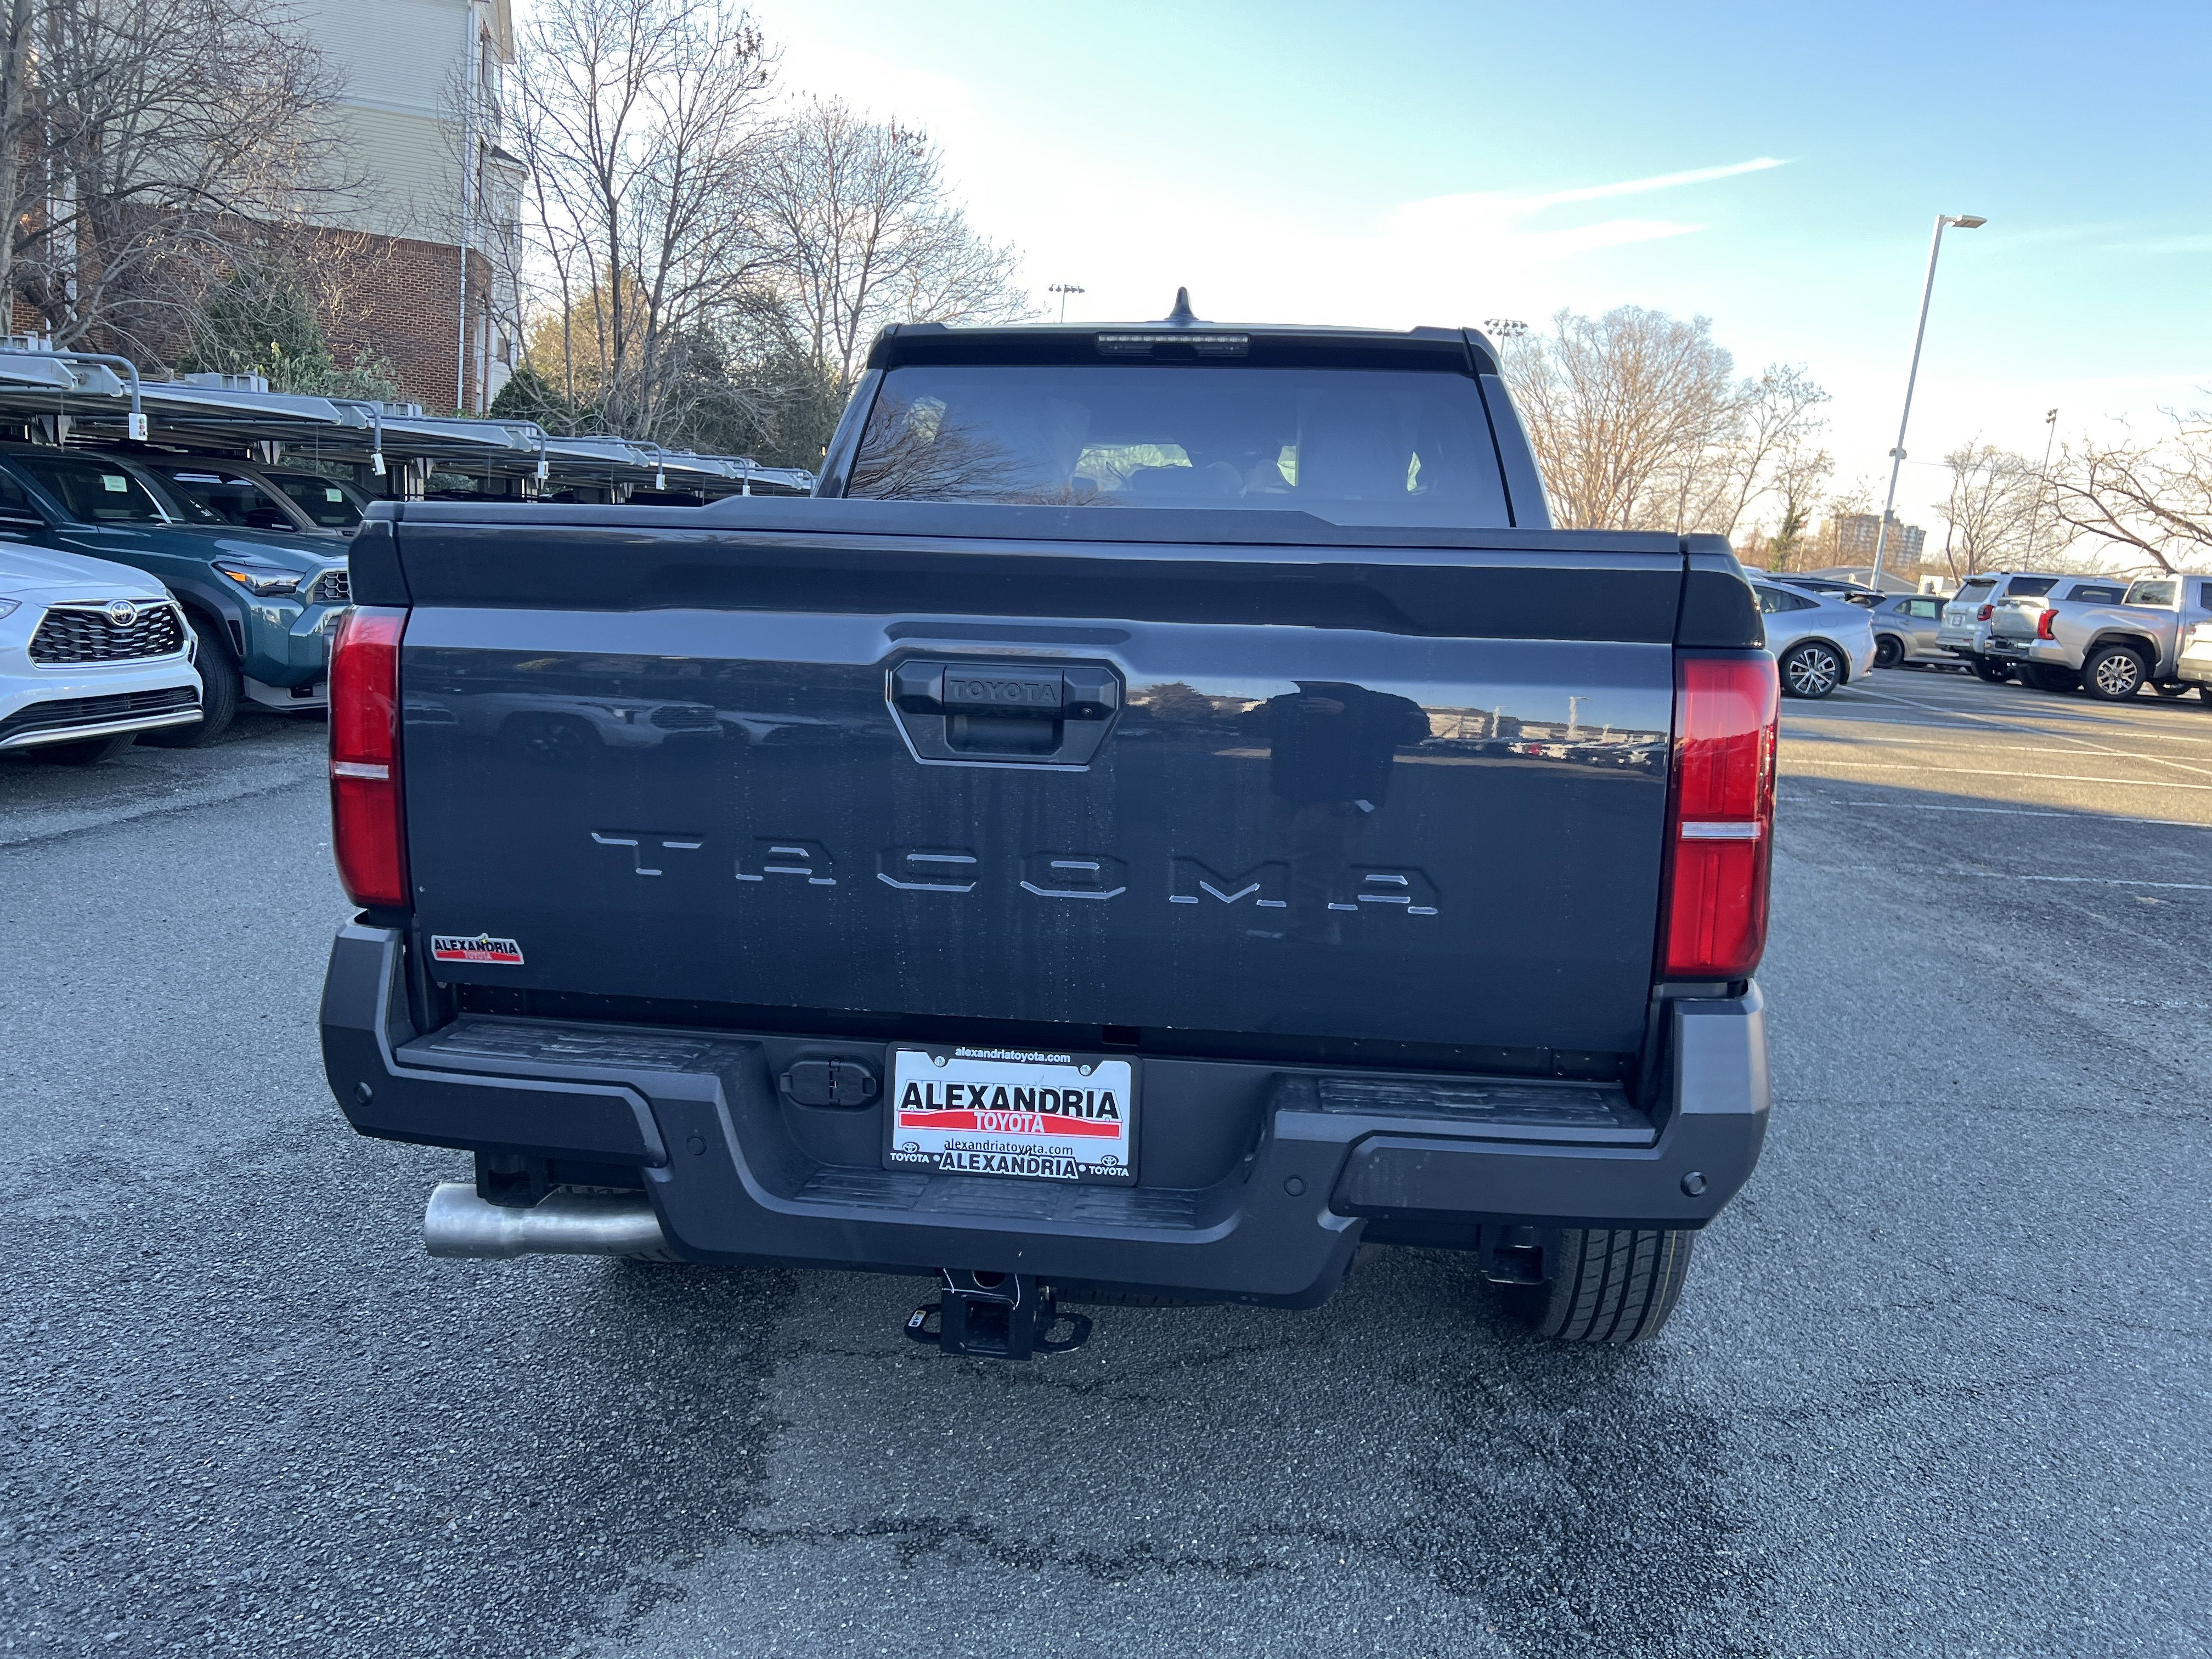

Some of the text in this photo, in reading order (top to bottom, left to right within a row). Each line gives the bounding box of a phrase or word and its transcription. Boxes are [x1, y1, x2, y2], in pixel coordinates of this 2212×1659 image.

[950, 680, 1057, 702] TOYOTA
[590, 827, 1441, 916] TACOMA
[435, 939, 518, 954] ALEXANDRIA
[955, 1047, 1071, 1063] alexandriatoyota.com
[901, 1082, 1119, 1120] ALEXANDRIA
[974, 1111, 1045, 1133] TOYOTA
[944, 1138, 1073, 1155] alexandriatoyota.com
[890, 1150, 1130, 1178] TOYOTA ALEXANDRIA TOYOTA
